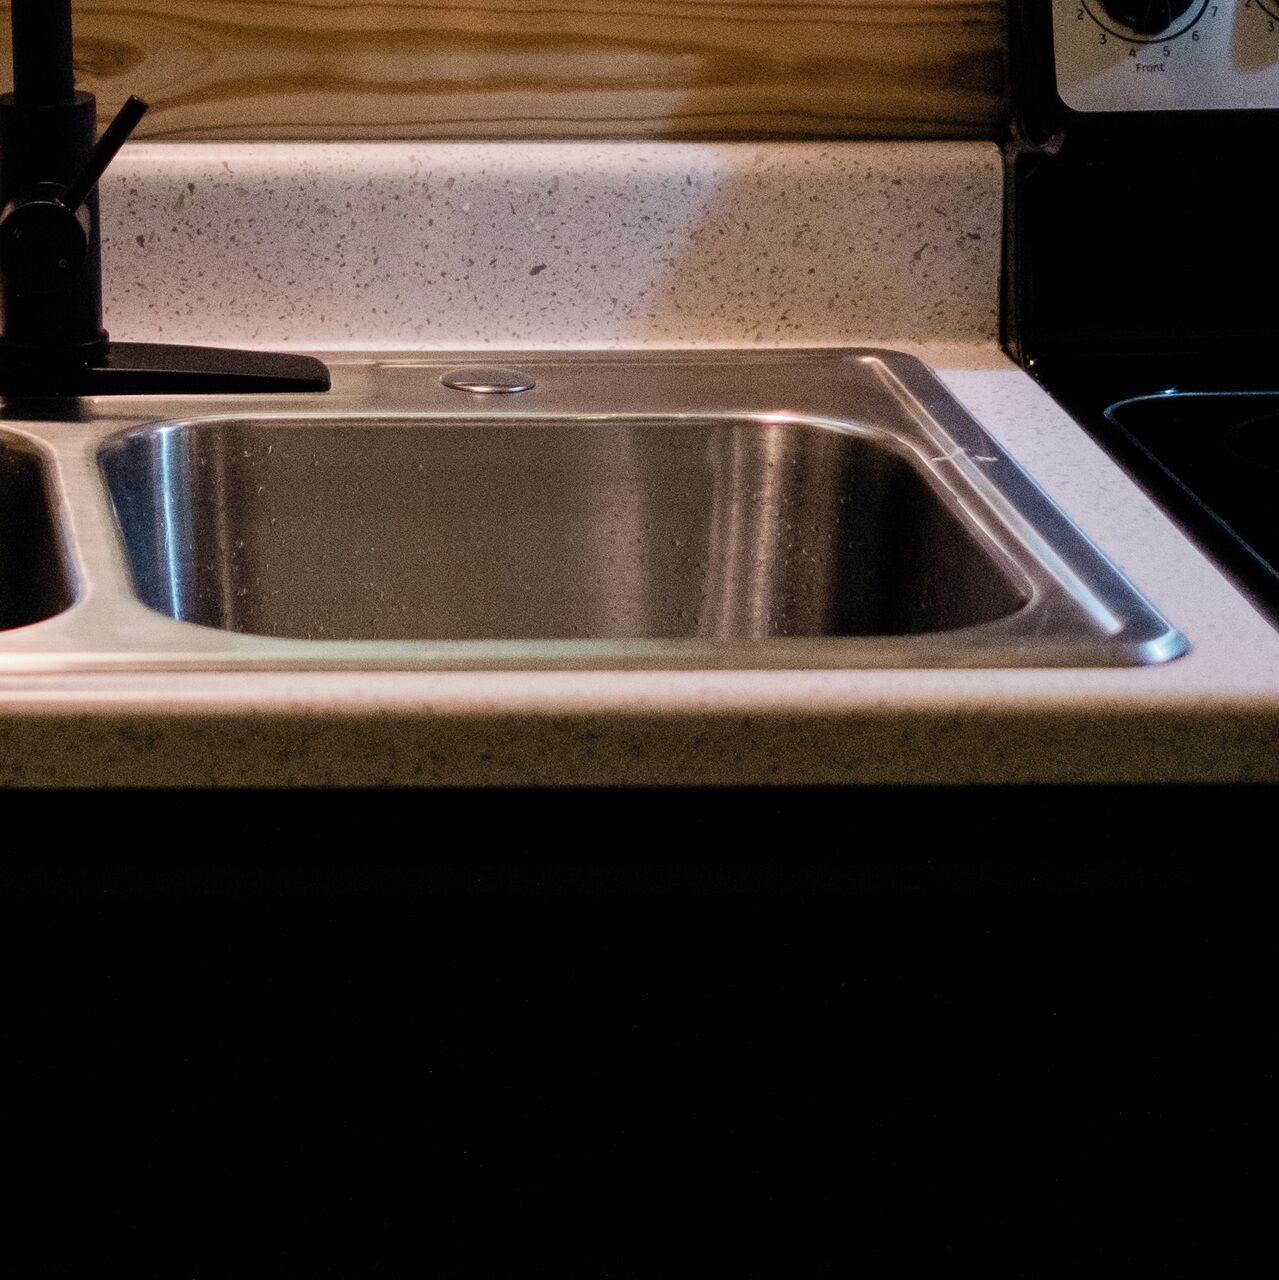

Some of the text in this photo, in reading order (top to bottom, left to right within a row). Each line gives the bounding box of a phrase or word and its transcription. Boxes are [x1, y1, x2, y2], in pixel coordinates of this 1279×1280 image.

[1077, 9, 1085, 20] 2
[1211, 6, 1219, 17] 7
[1267, 21, 1275, 32] 3
[1099, 33, 1107, 45] 3
[1192, 30, 1200, 42] 6
[1128, 47, 1137, 57] 4
[1163, 45, 1171, 57] 5
[1136, 63, 1165, 73] Front
